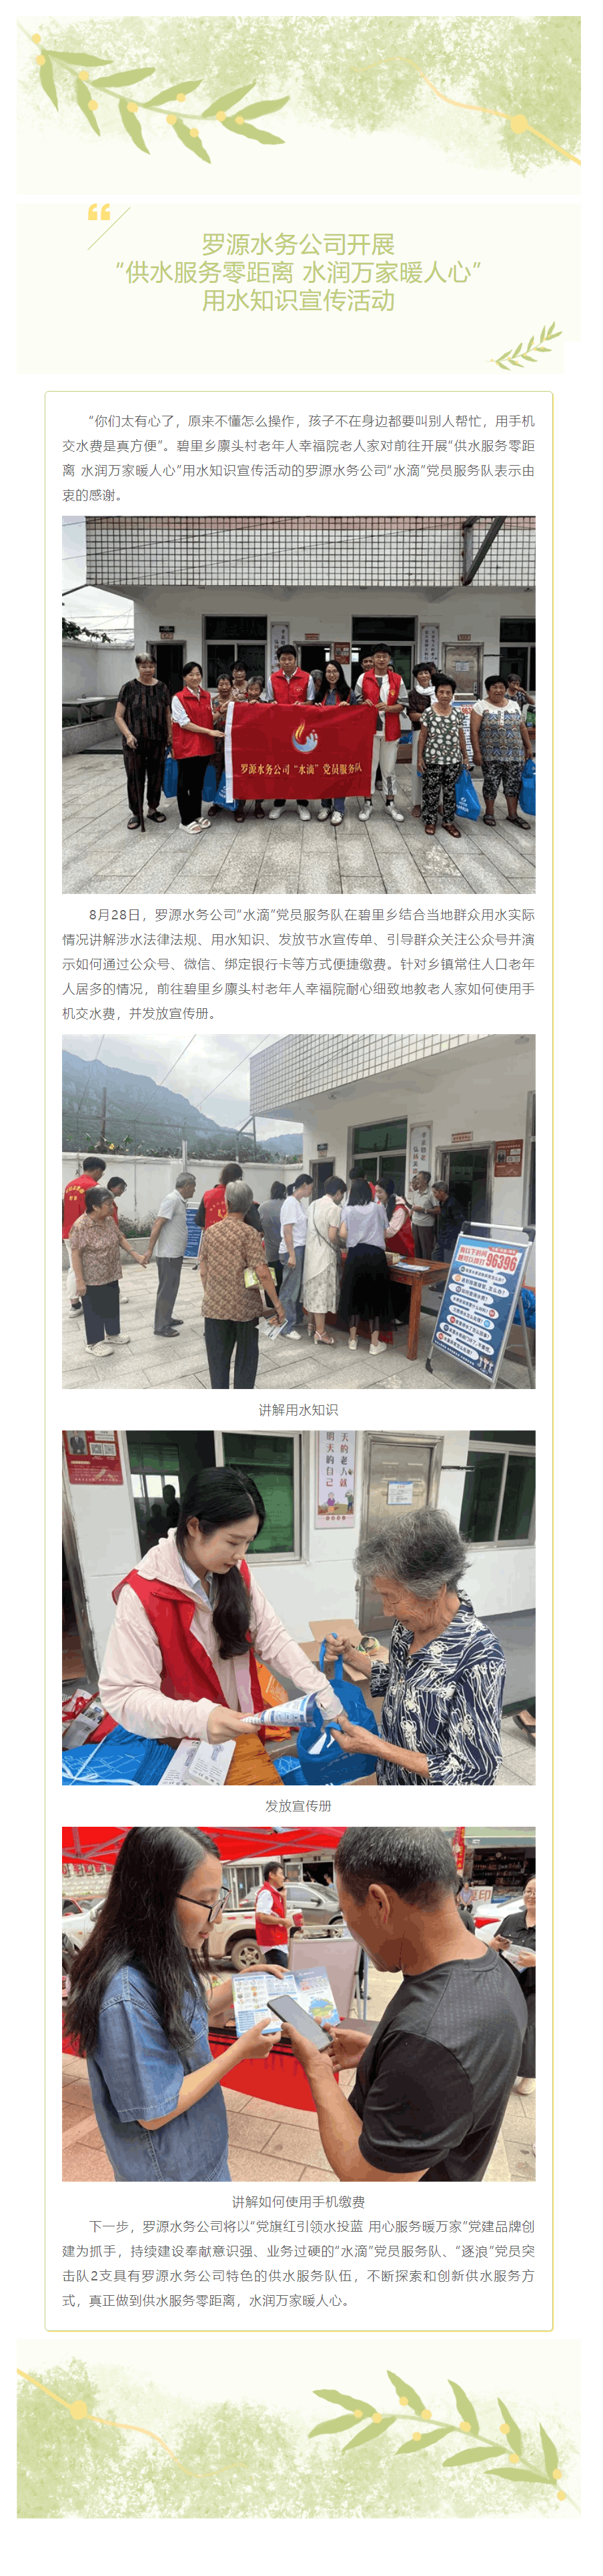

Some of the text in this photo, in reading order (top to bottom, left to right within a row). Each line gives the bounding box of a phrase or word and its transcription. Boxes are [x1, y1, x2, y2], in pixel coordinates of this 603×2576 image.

[486, 1253, 517, 1272] 96396
[326, 1431, 334, 1486] 明天的自己
[340, 1432, 348, 1487] 天的老人就
